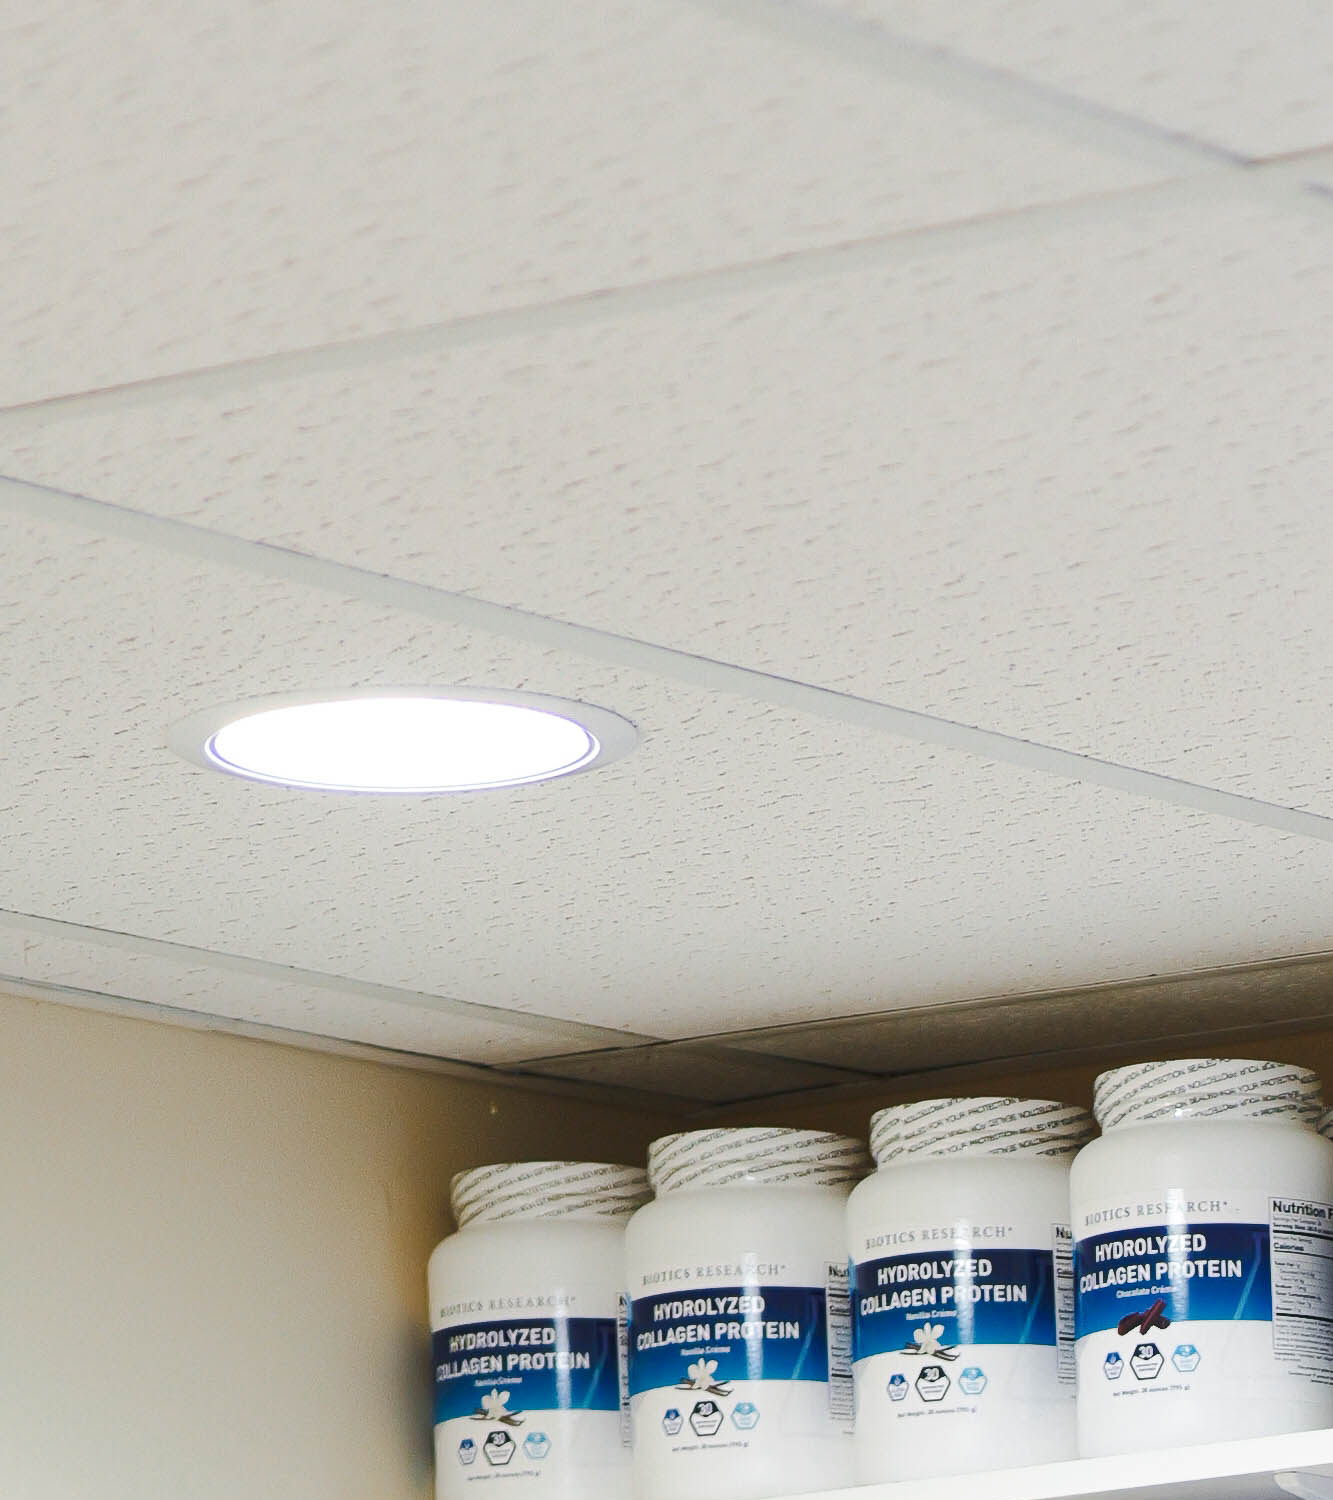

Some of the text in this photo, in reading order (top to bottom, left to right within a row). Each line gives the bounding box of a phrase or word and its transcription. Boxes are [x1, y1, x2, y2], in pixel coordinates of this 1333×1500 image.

[1095, 1233, 1206, 1263] HYDROLYZED
[876, 1256, 992, 1286] HYDROLYZED
[1080, 1259, 1242, 1294] COLLAGEN PROTEIN
[652, 1294, 765, 1322] HYDROLYZED
[860, 1282, 1028, 1315] COLLAGEN PROTEIN
[449, 1326, 556, 1351] HYDROLYZED
[636, 1319, 800, 1350] COLLAGEN PROTEIN
[506, 1349, 590, 1374] PROTEIN
